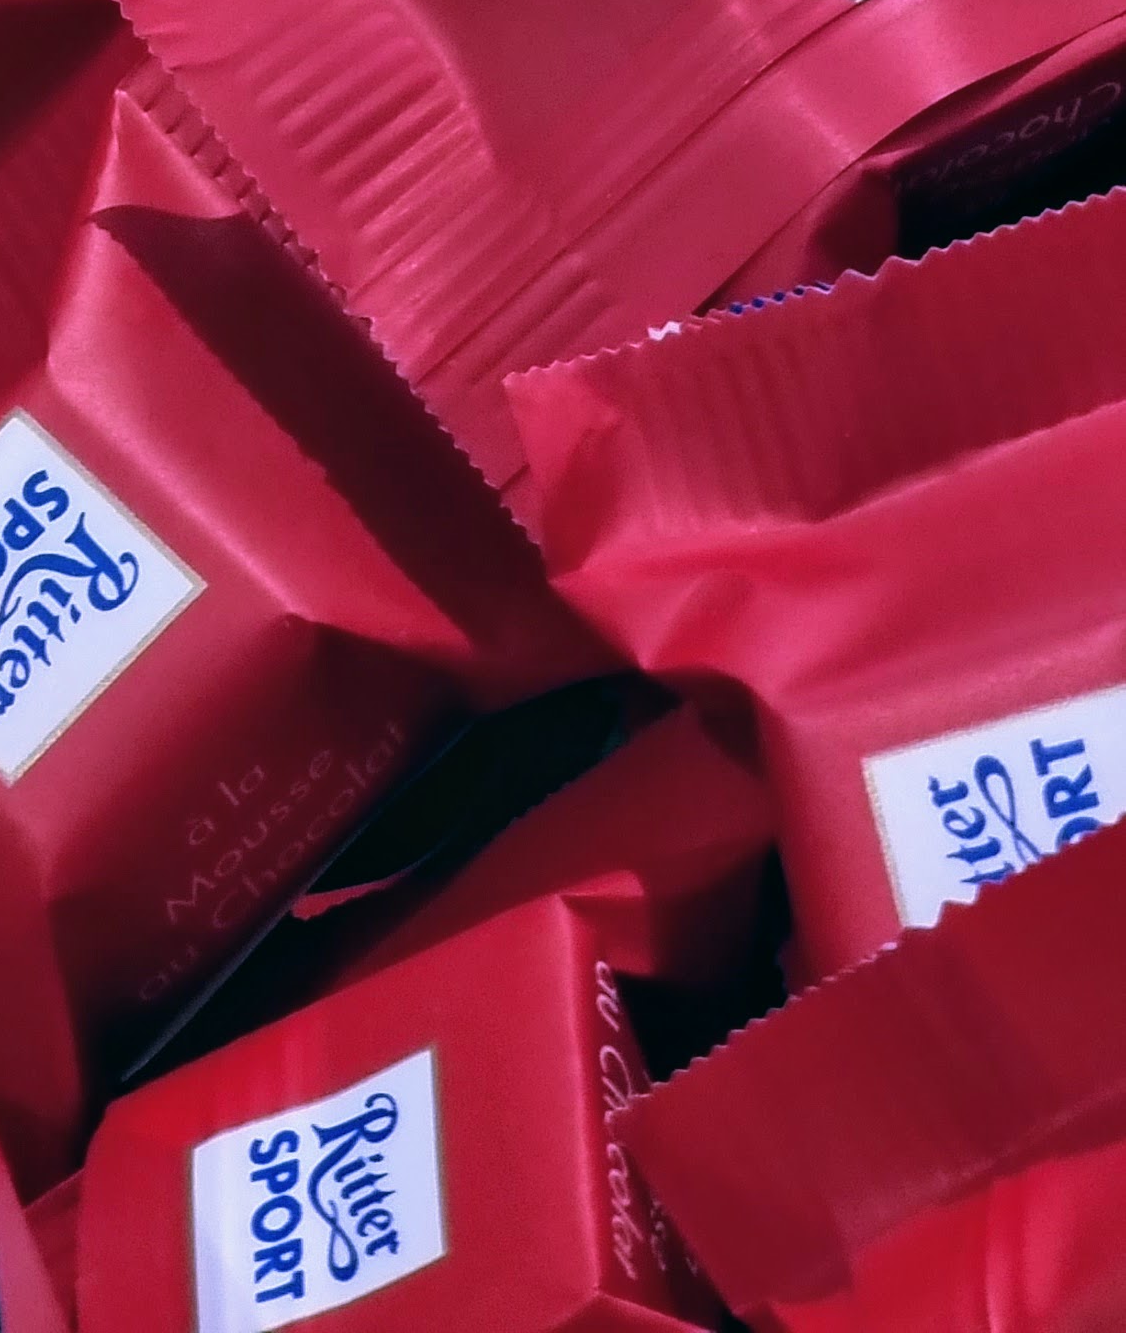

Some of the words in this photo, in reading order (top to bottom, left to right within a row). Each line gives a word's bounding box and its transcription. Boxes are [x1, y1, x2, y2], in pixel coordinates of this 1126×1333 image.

[166, 749, 332, 924] Mousse
[928, 755, 1040, 884] tter
[249, 1129, 306, 1303] SPORT
[308, 1092, 399, 1283] Ritter
